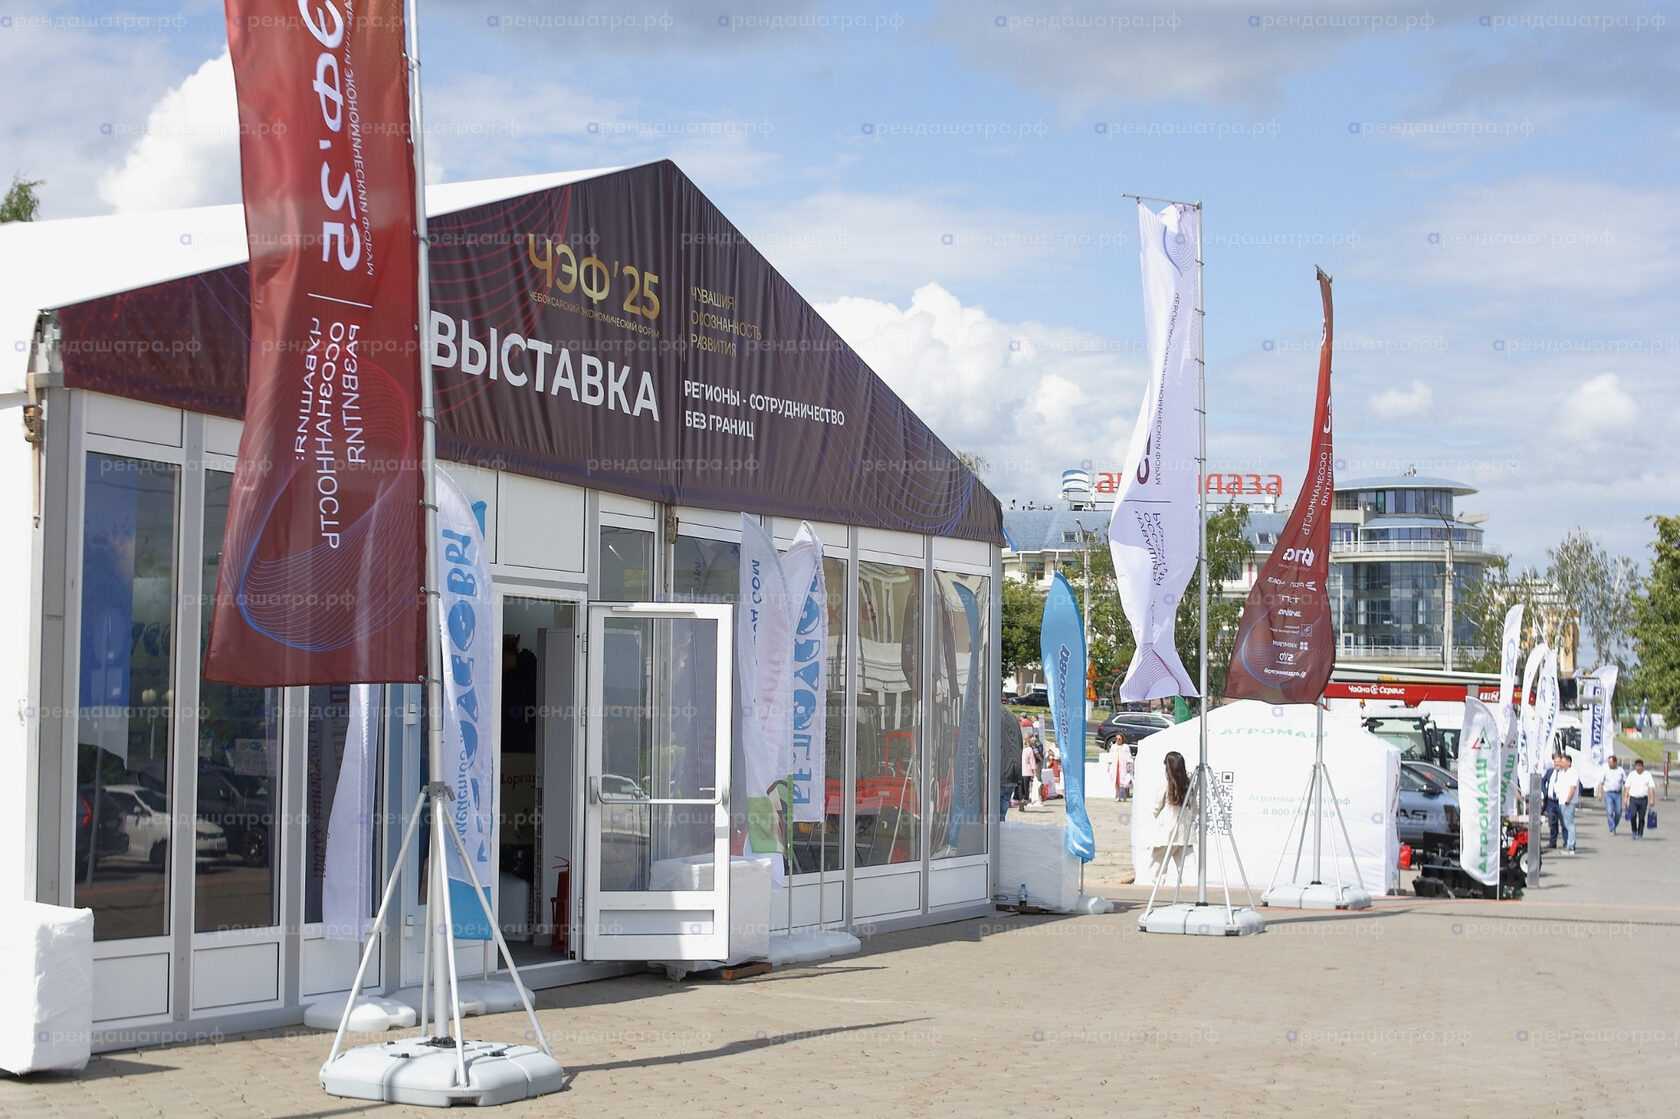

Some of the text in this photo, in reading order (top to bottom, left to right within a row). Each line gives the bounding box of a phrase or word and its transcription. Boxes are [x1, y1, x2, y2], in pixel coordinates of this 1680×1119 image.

[528, 233, 661, 320] ЧЭФ'25
[581, 305, 638, 333] ЭКОНОМИЧЕСКИЙ
[691, 311, 762, 341] ОСОЗНАННОСТЬ
[690, 333, 737, 358] РАЗВИТИЯ
[430, 310, 660, 422] ВЫСТАВКА
[684, 379, 740, 407] РЕГИОНЫ
[749, 393, 845, 426] СОТРУДНИЧЕСТВО
[685, 410, 755, 440] БЕЗ ГРАНИЦ
[1378, 685, 1405, 695] Сервис
[1220, 726, 1329, 739] АГРОМАШ
[1475, 757, 1489, 874] АГРОМАШ
